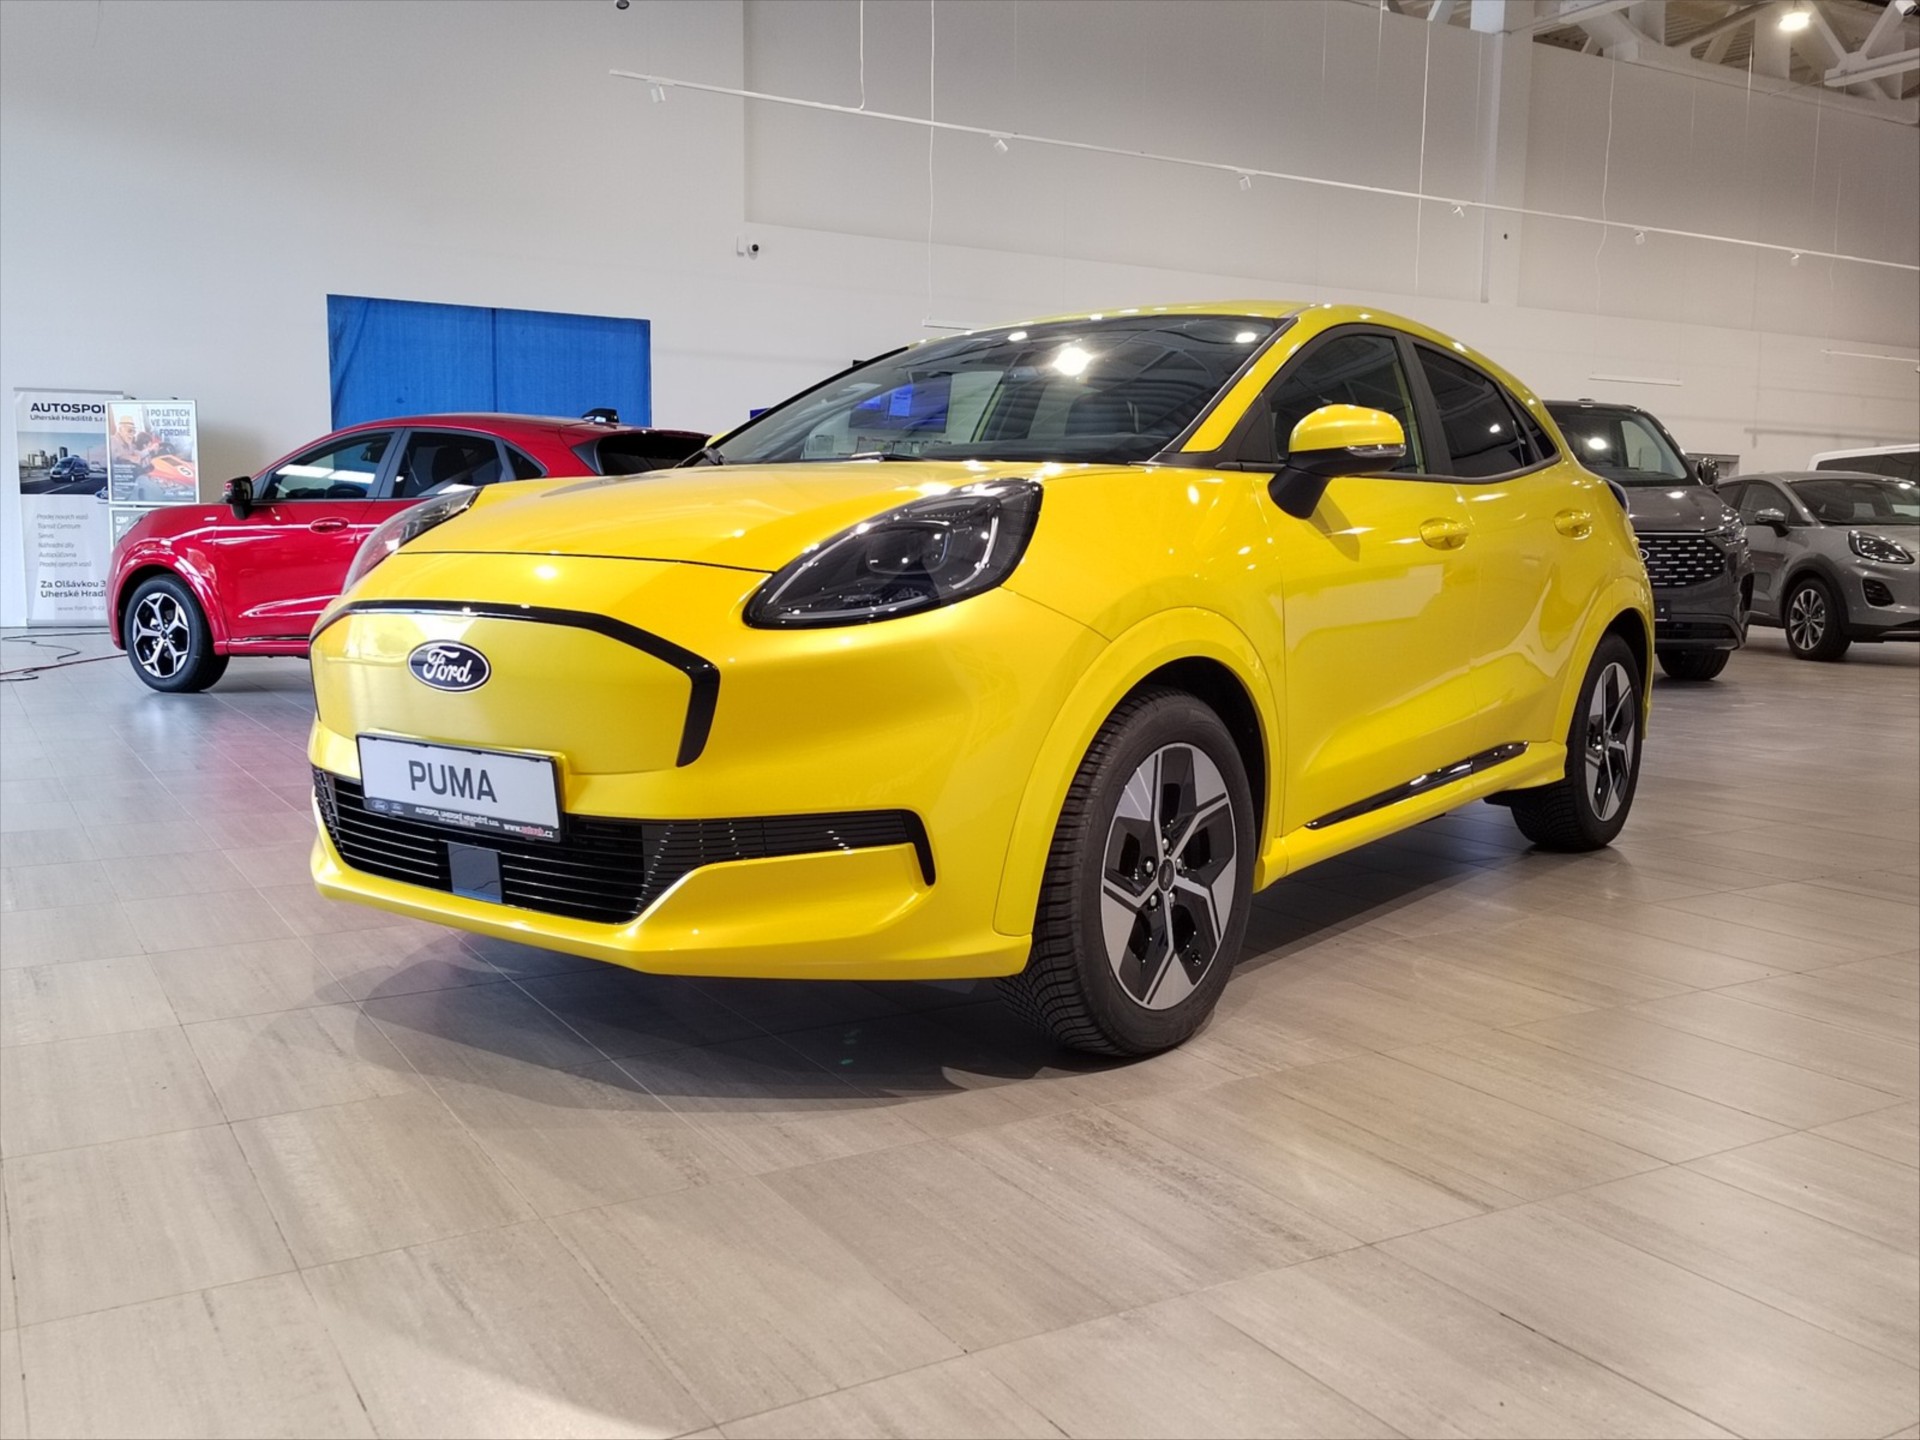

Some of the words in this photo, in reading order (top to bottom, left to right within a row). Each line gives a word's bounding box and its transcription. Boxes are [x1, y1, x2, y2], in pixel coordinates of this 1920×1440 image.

[40, 580, 53, 588] Za
[40, 590, 80, 598] Uherské
[81, 590, 107, 598] Hradi
[408, 760, 498, 803] PUMA
